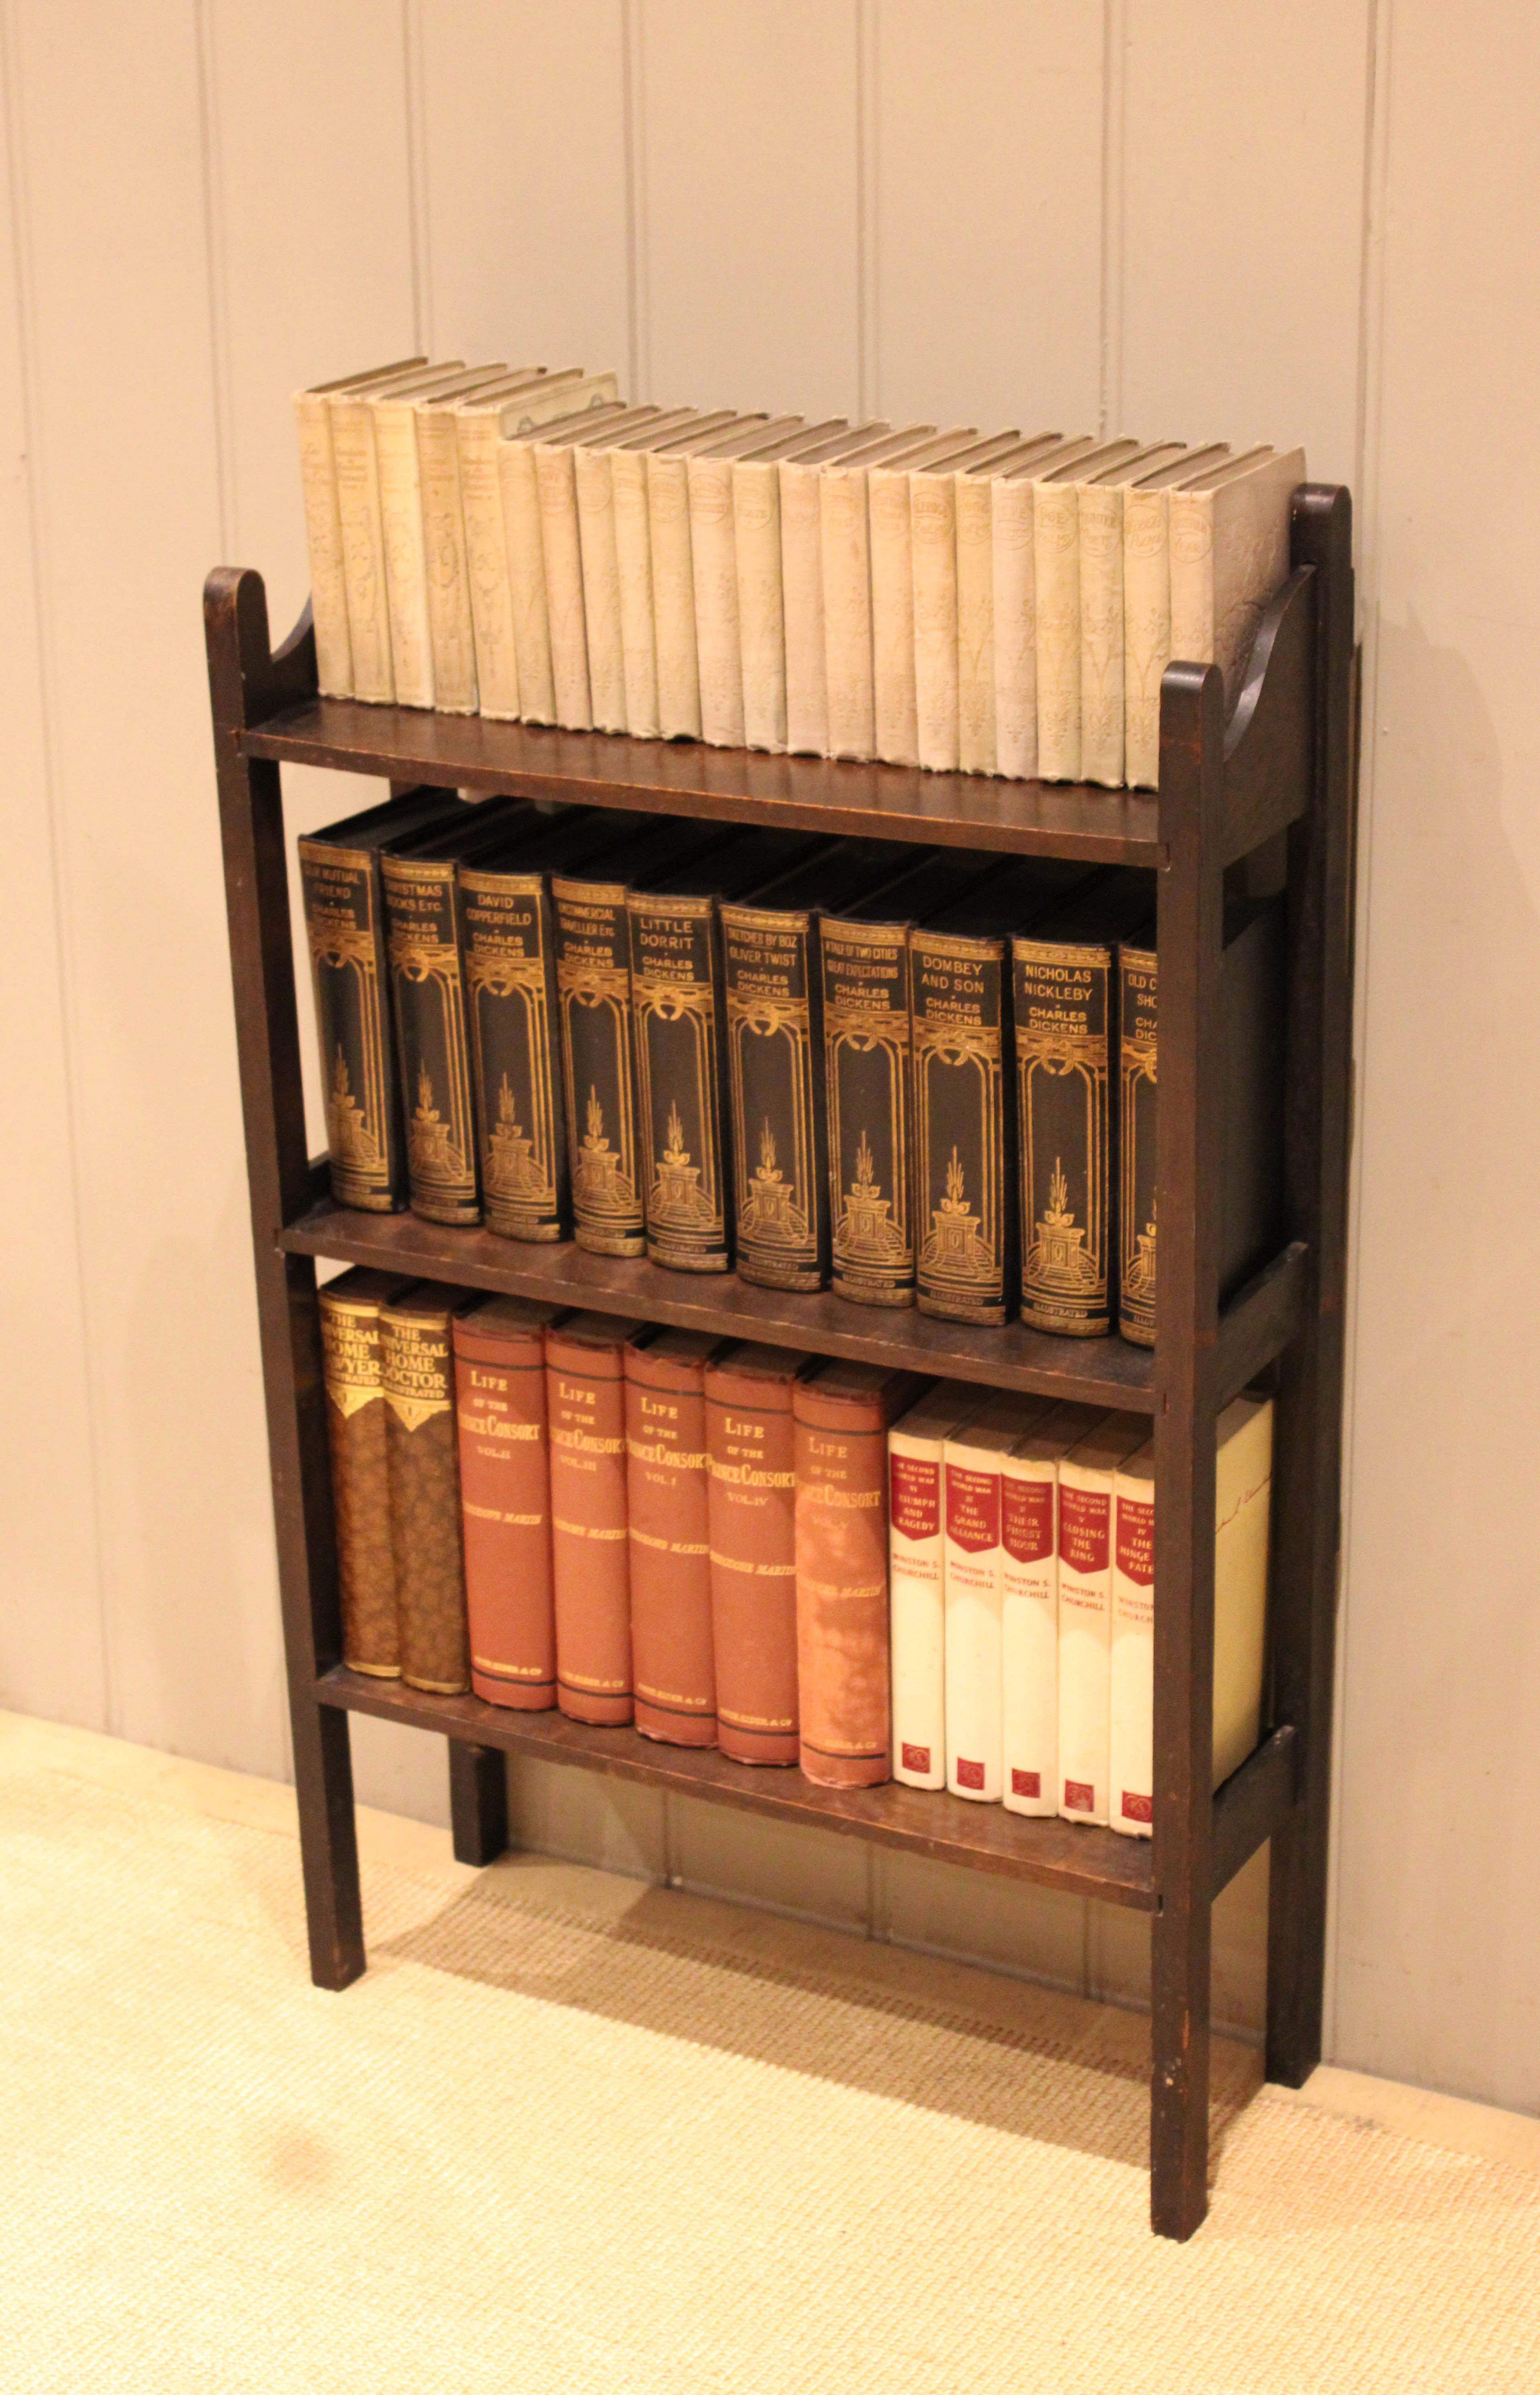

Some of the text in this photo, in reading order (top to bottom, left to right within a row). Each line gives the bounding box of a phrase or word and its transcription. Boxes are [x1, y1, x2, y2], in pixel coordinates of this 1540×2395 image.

[478, 894, 514, 909] DAVID
[466, 907, 532, 926] COPPERFIELD
[640, 918, 693, 933] LITTLE
[473, 932, 524, 946] CHARLES
[640, 932, 694, 950] DORRIT
[778, 935, 797, 948] BOZ
[474, 943, 525, 957] DICKENS
[564, 941, 613, 957] CHARLES
[729, 946, 796, 966] OLIVER TWIST
[642, 956, 693, 970] CHARLES
[923, 955, 982, 976] DOMBEY
[643, 967, 695, 981] DICKENS
[737, 970, 788, 986] CHARLES
[1025, 965, 1091, 983] NICHOLAS
[1128, 973, 1146, 988] OLD
[738, 981, 790, 998] DICKENS
[835, 984, 889, 999] CHARLES
[922, 973, 984, 994] AND SON
[1024, 982, 1093, 1001] NICKLEBY
[835, 995, 890, 1010] DICKENS
[926, 997, 981, 1014] CHARLES
[926, 1009, 982, 1026] DICKENS
[1029, 1006, 1087, 1022] CHARLES
[1029, 1018, 1088, 1034] DICKENS
[392, 1325, 421, 1341] THE
[385, 1350, 435, 1367] HOME
[743, 1449, 764, 1459] THE
[903, 1507, 923, 1518] AND
[960, 1504, 979, 1515] THE
[1072, 1537, 1092, 1550] THE
[1132, 1537, 1152, 1549] THE
